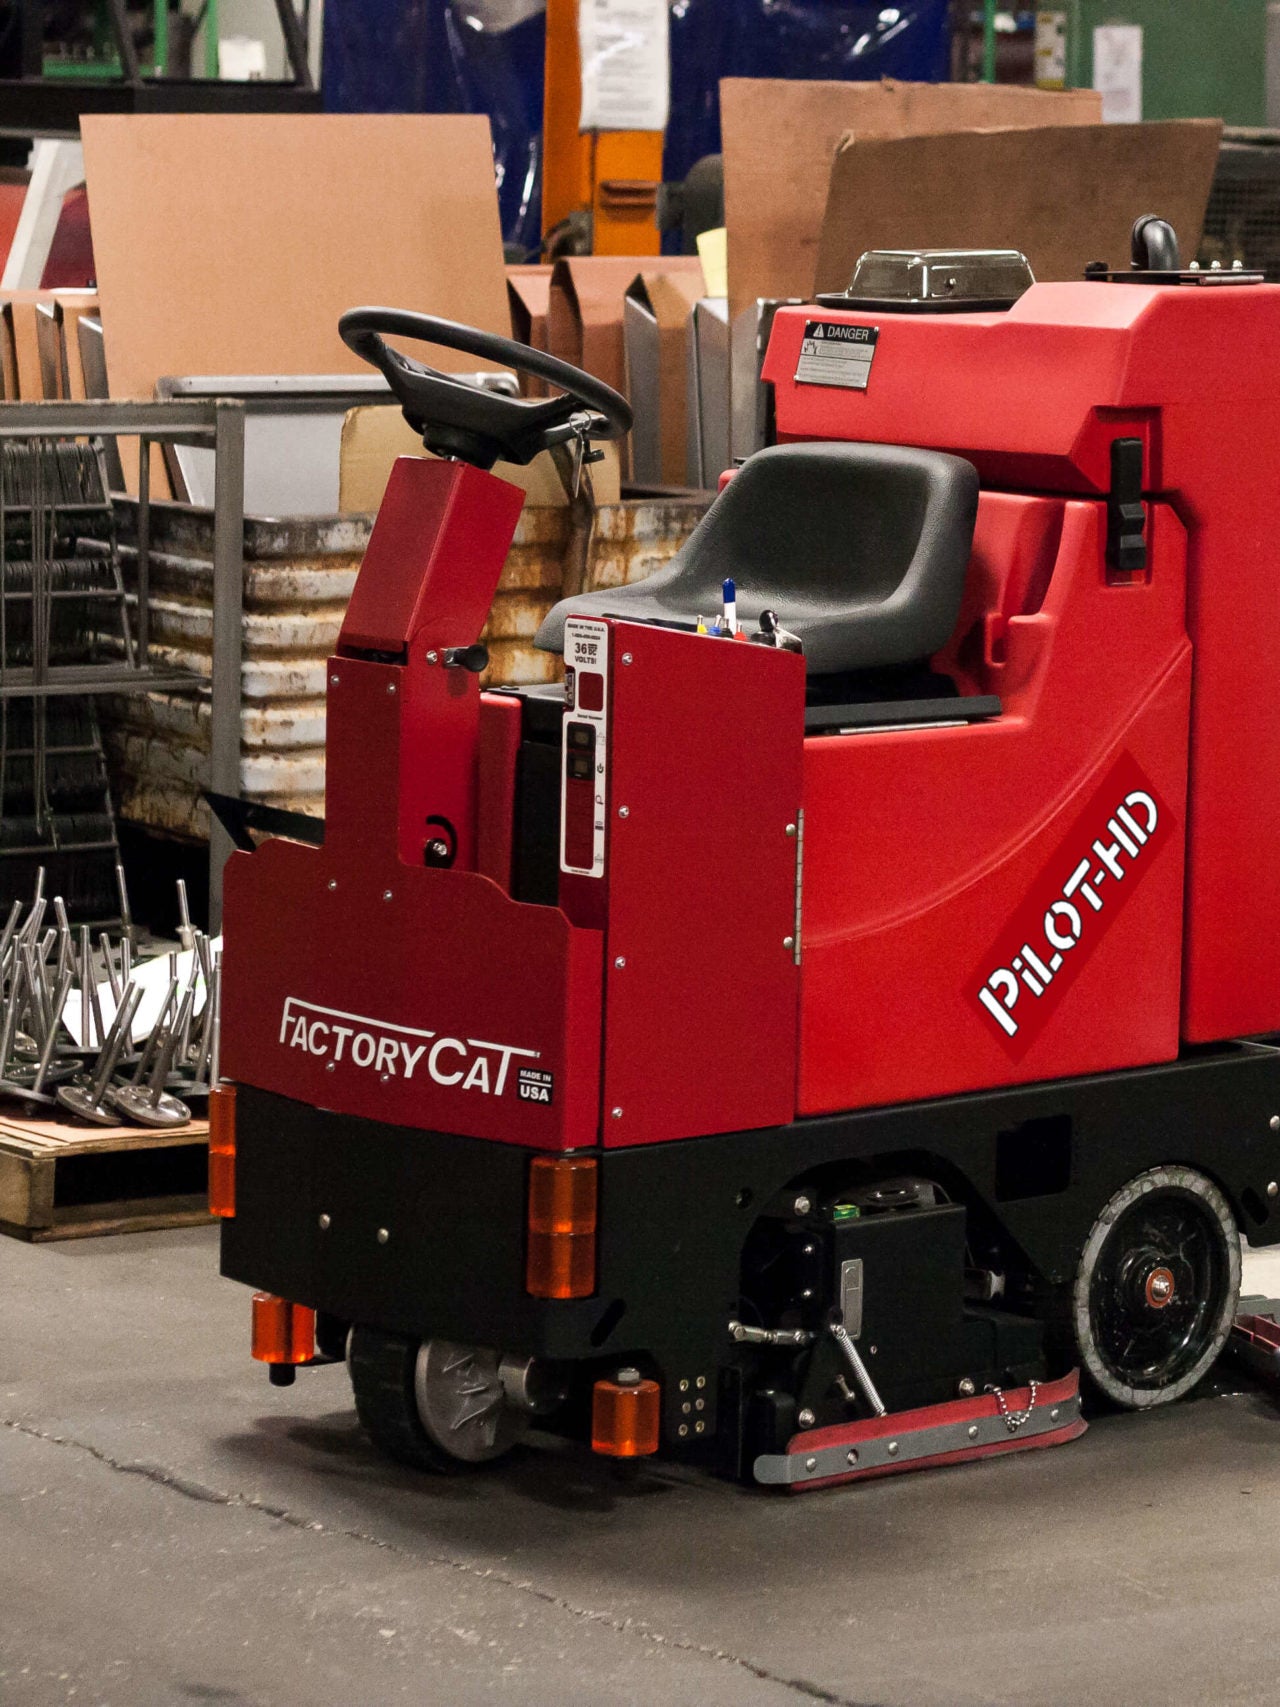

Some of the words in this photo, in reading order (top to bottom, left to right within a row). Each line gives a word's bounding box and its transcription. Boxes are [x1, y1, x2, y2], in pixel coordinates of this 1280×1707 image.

[827, 326, 869, 340] DANGER
[575, 642, 587, 654] 36
[520, 1070, 542, 1080] MADE
[543, 1074, 552, 1082] IN
[520, 1084, 549, 1102] USA
